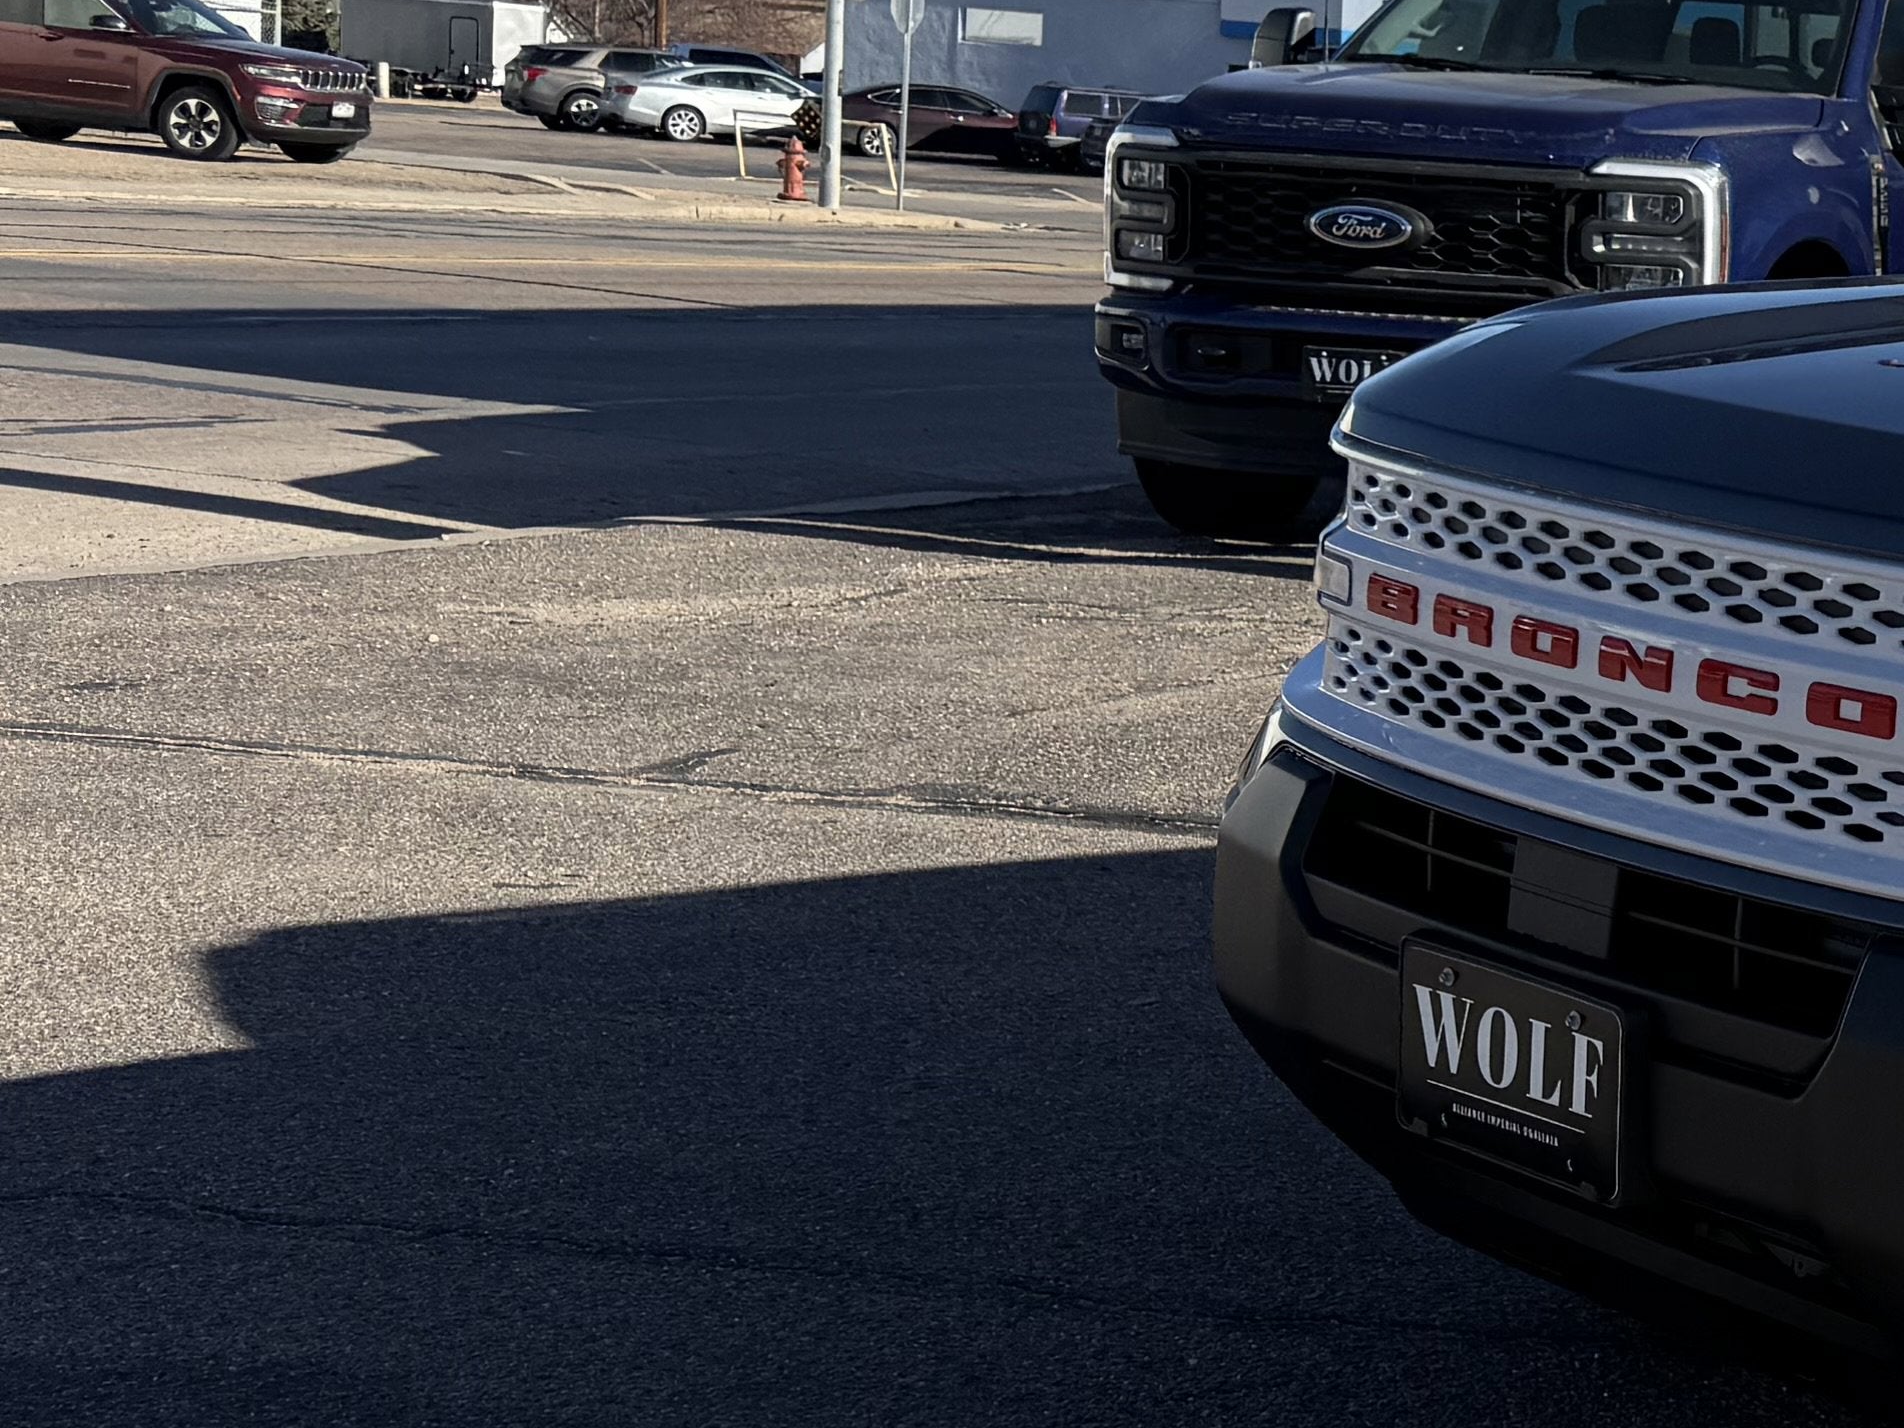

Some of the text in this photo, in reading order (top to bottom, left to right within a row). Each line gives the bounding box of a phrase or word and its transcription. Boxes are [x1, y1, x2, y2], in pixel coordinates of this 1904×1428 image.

[1332, 213, 1387, 239] Ford
[1308, 356, 1391, 384] WOL
[1365, 571, 1898, 742] BRONCO
[1411, 982, 1605, 1119] WOLF
